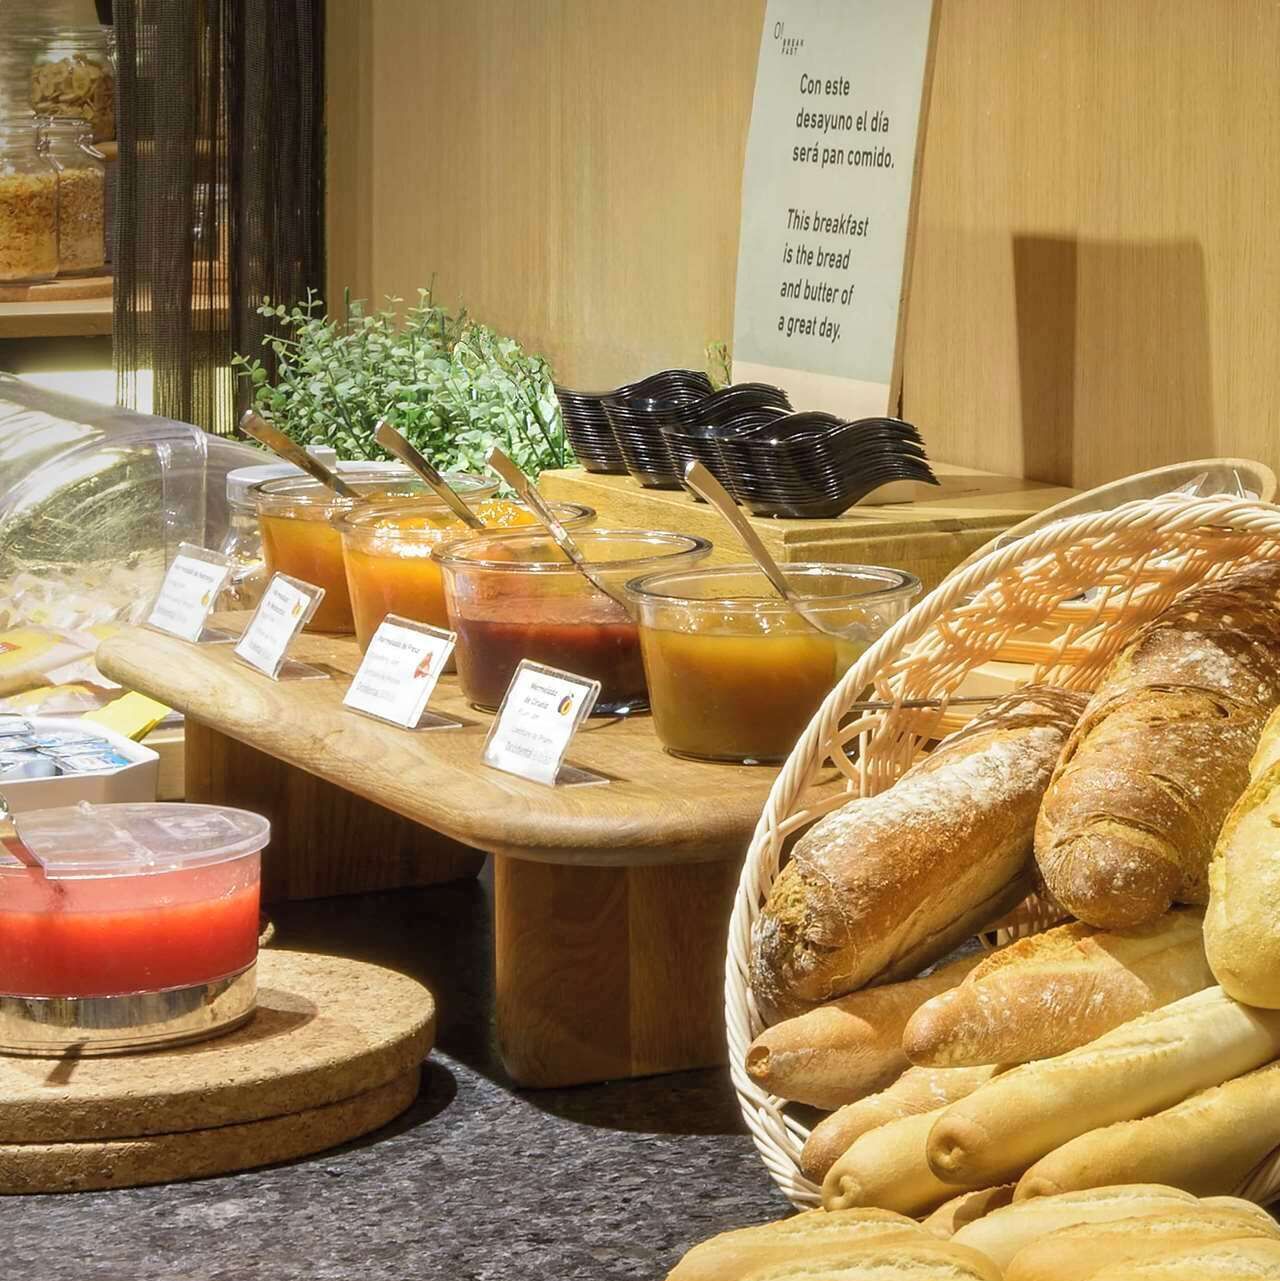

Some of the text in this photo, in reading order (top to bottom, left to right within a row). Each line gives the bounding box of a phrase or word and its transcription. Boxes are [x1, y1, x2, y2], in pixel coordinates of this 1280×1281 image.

[782, 38, 804, 47] BREAK
[800, 73, 850, 96] Con este
[796, 107, 889, 134] desayuno el día
[792, 141, 895, 169] será pan comido.
[787, 208, 869, 237] This breakfast
[783, 242, 851, 270] is the bread
[780, 278, 855, 306] and butter of
[777, 315, 841, 344] a great day.
